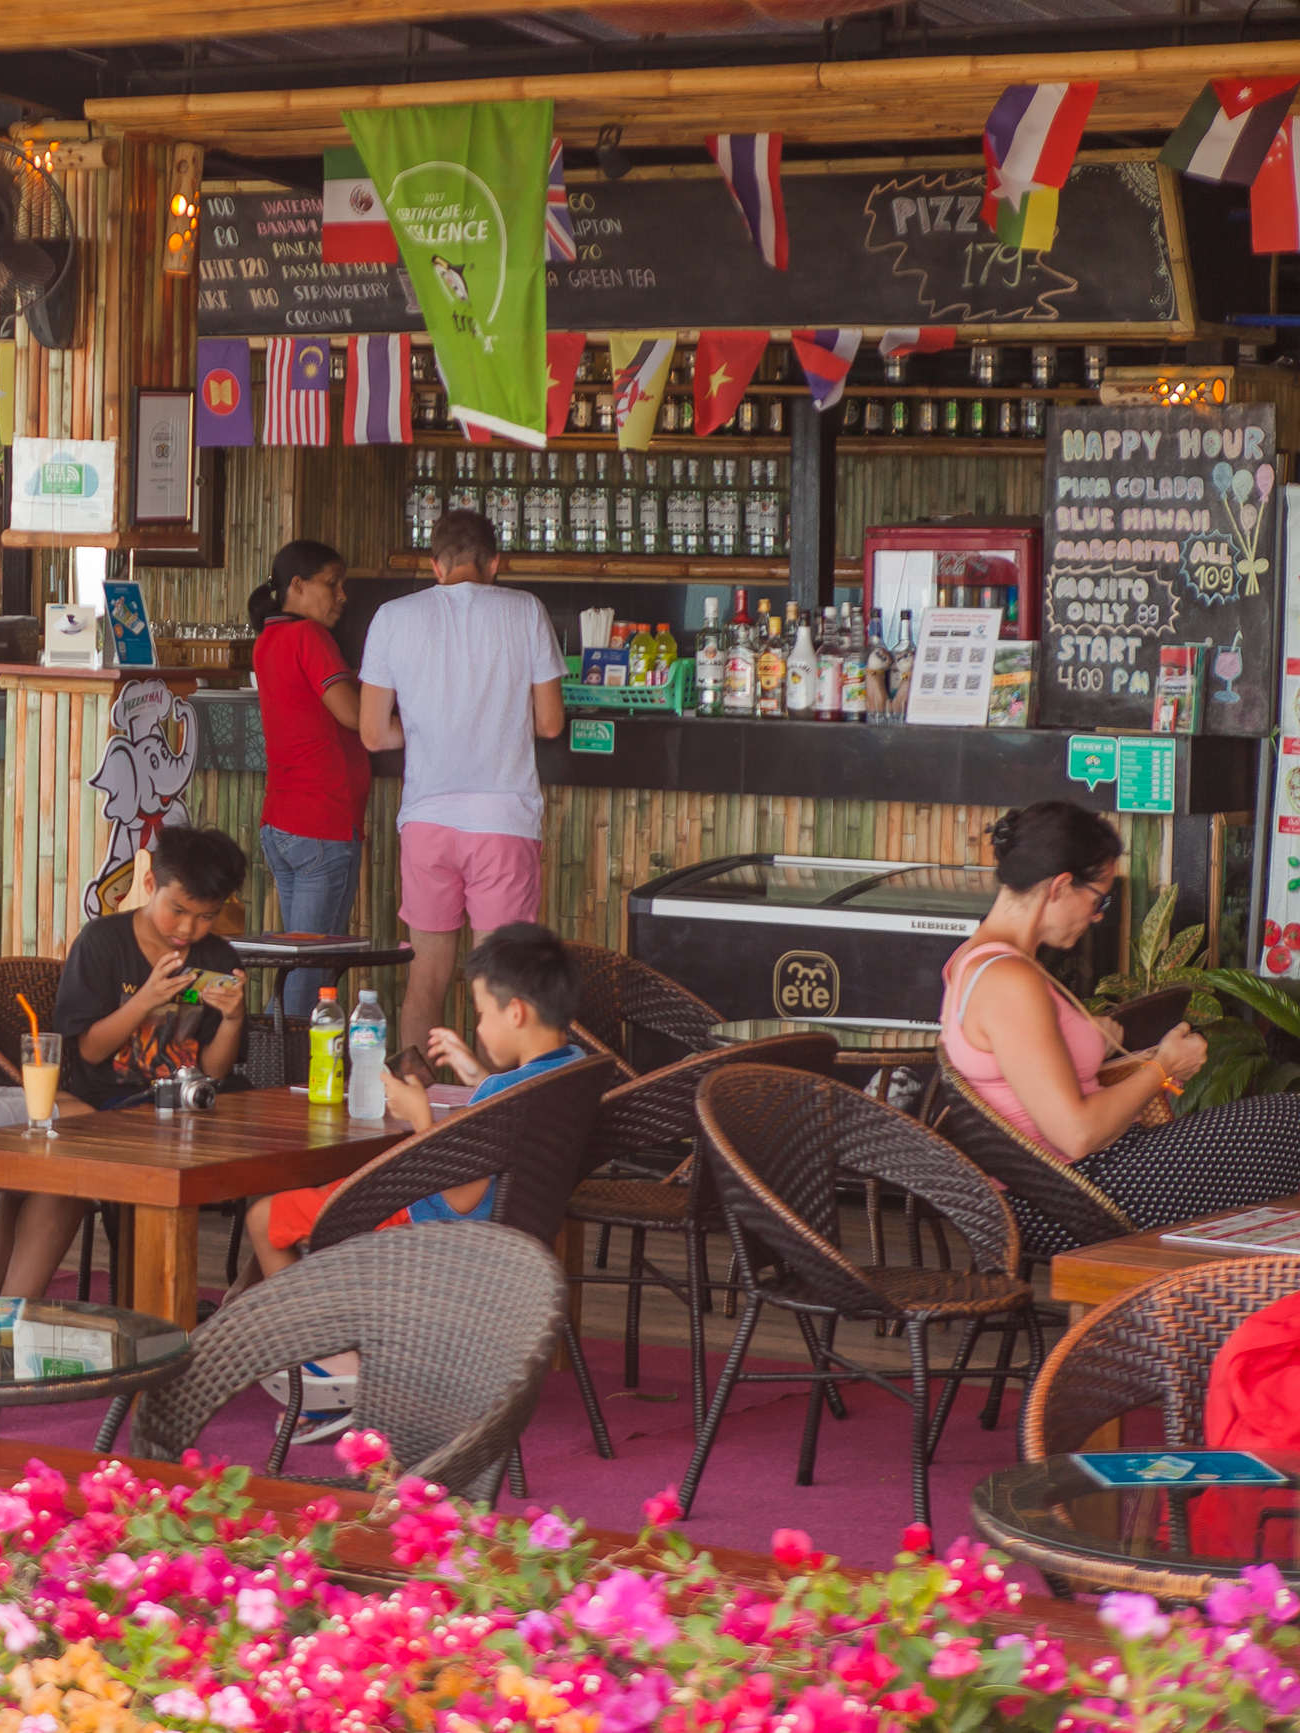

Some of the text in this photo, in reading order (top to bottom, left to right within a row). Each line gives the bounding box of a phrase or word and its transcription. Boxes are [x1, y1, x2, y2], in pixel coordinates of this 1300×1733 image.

[206, 197, 235, 217] 100
[424, 193, 445, 204] 2017
[568, 193, 595, 212] 60
[464, 204, 479, 220] of
[892, 196, 981, 234] PIZZ
[213, 226, 239, 247] 80
[257, 219, 318, 236] BANANA
[570, 218, 622, 237] LIPTON
[579, 244, 602, 260] 70
[200, 257, 269, 279] THIE 120
[281, 262, 341, 280] PASSION
[546, 268, 656, 288] A GREEN TEA
[199, 287, 279, 309] AKE 100
[293, 282, 390, 300] STRAWBERRY
[285, 308, 352, 326] COCONUT
[1062, 426, 1265, 461] HAPPY HOUR
[45, 464, 66, 474] FREE
[1057, 476, 1204, 499] PINA COLADA
[1056, 505, 1211, 531] BLUE HAWAII
[1055, 538, 1180, 563] MARGARITA
[1189, 541, 1232, 565] ALL
[1194, 565, 1233, 592] 109
[1055, 577, 1149, 601] MOJITO
[1067, 602, 1160, 626] ONLY 89
[1057, 635, 1142, 664] START
[1058, 665, 1104, 691] 4.00
[1111, 668, 1150, 694] PM
[123, 689, 163, 717] PIZZATHAI
[574, 721, 597, 731] FREE
[1073, 741, 1114, 751] REVIEW US
[911, 920, 967, 932] LIEBHERR
